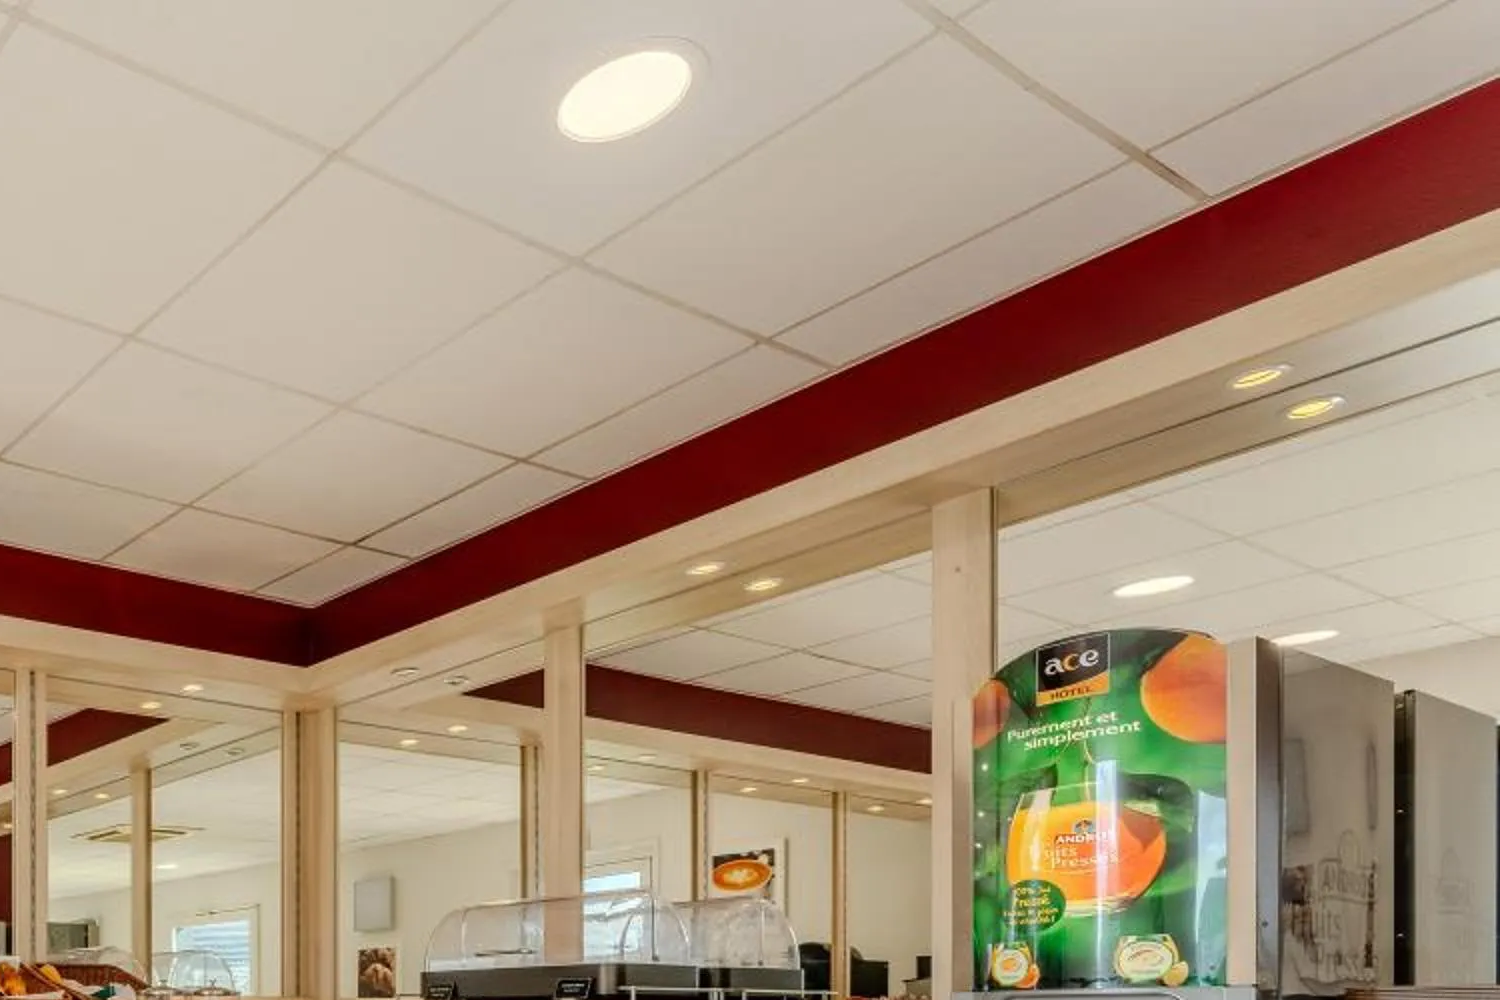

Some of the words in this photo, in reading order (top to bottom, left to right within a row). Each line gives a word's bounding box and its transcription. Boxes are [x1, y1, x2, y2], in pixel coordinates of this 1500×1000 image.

[1043, 648, 1100, 676] ace
[1050, 686, 1091, 701] HOTEL
[1007, 716, 1093, 744] Purement
[1096, 711, 1119, 723] et
[1023, 720, 1142, 751] simplement
